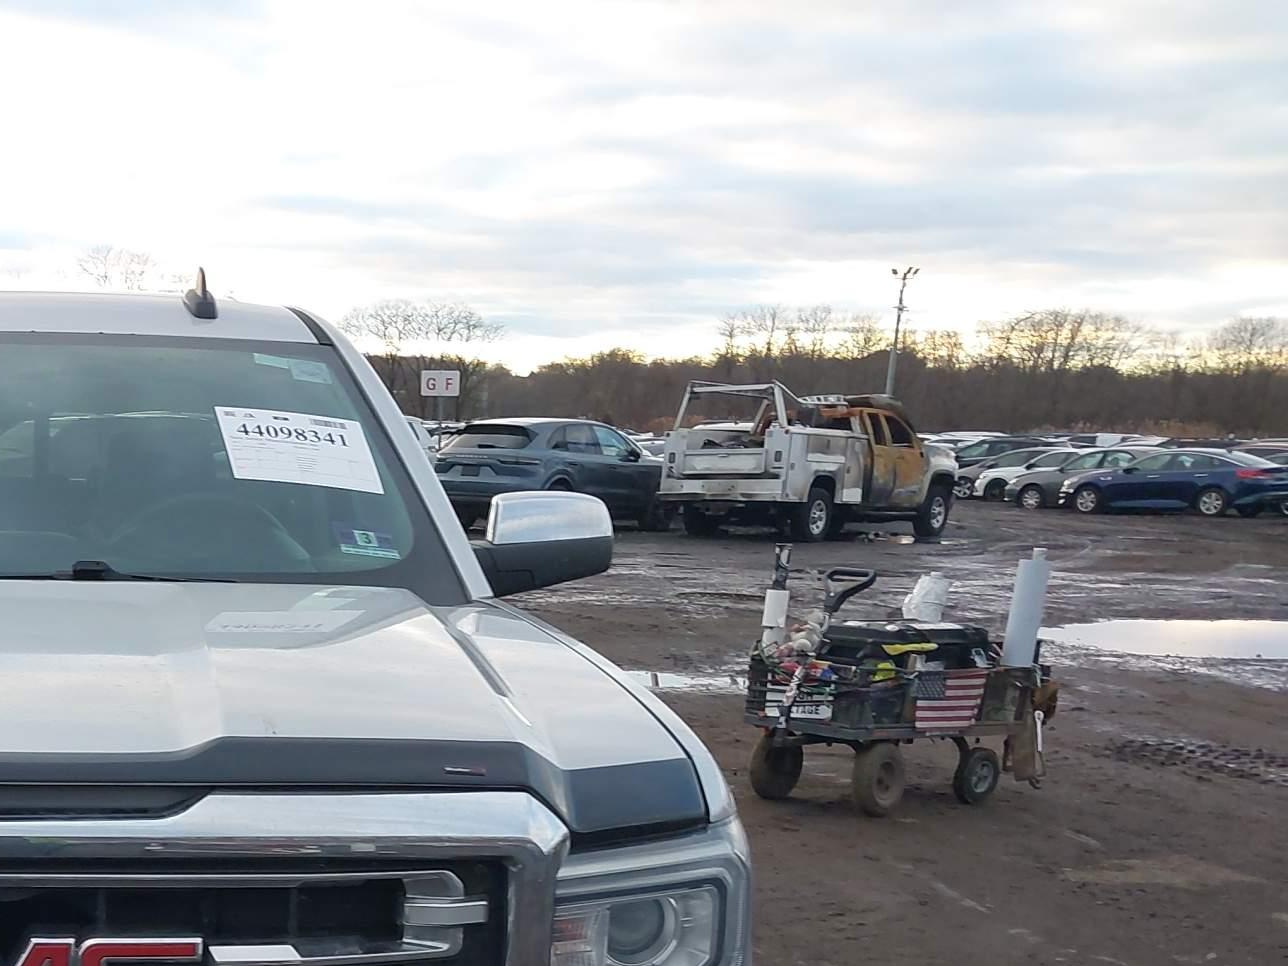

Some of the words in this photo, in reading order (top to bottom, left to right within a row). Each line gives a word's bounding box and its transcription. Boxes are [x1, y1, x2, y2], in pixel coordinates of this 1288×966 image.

[426, 377, 437, 391] G
[444, 377, 454, 391] F
[236, 422, 351, 448] 44098341
